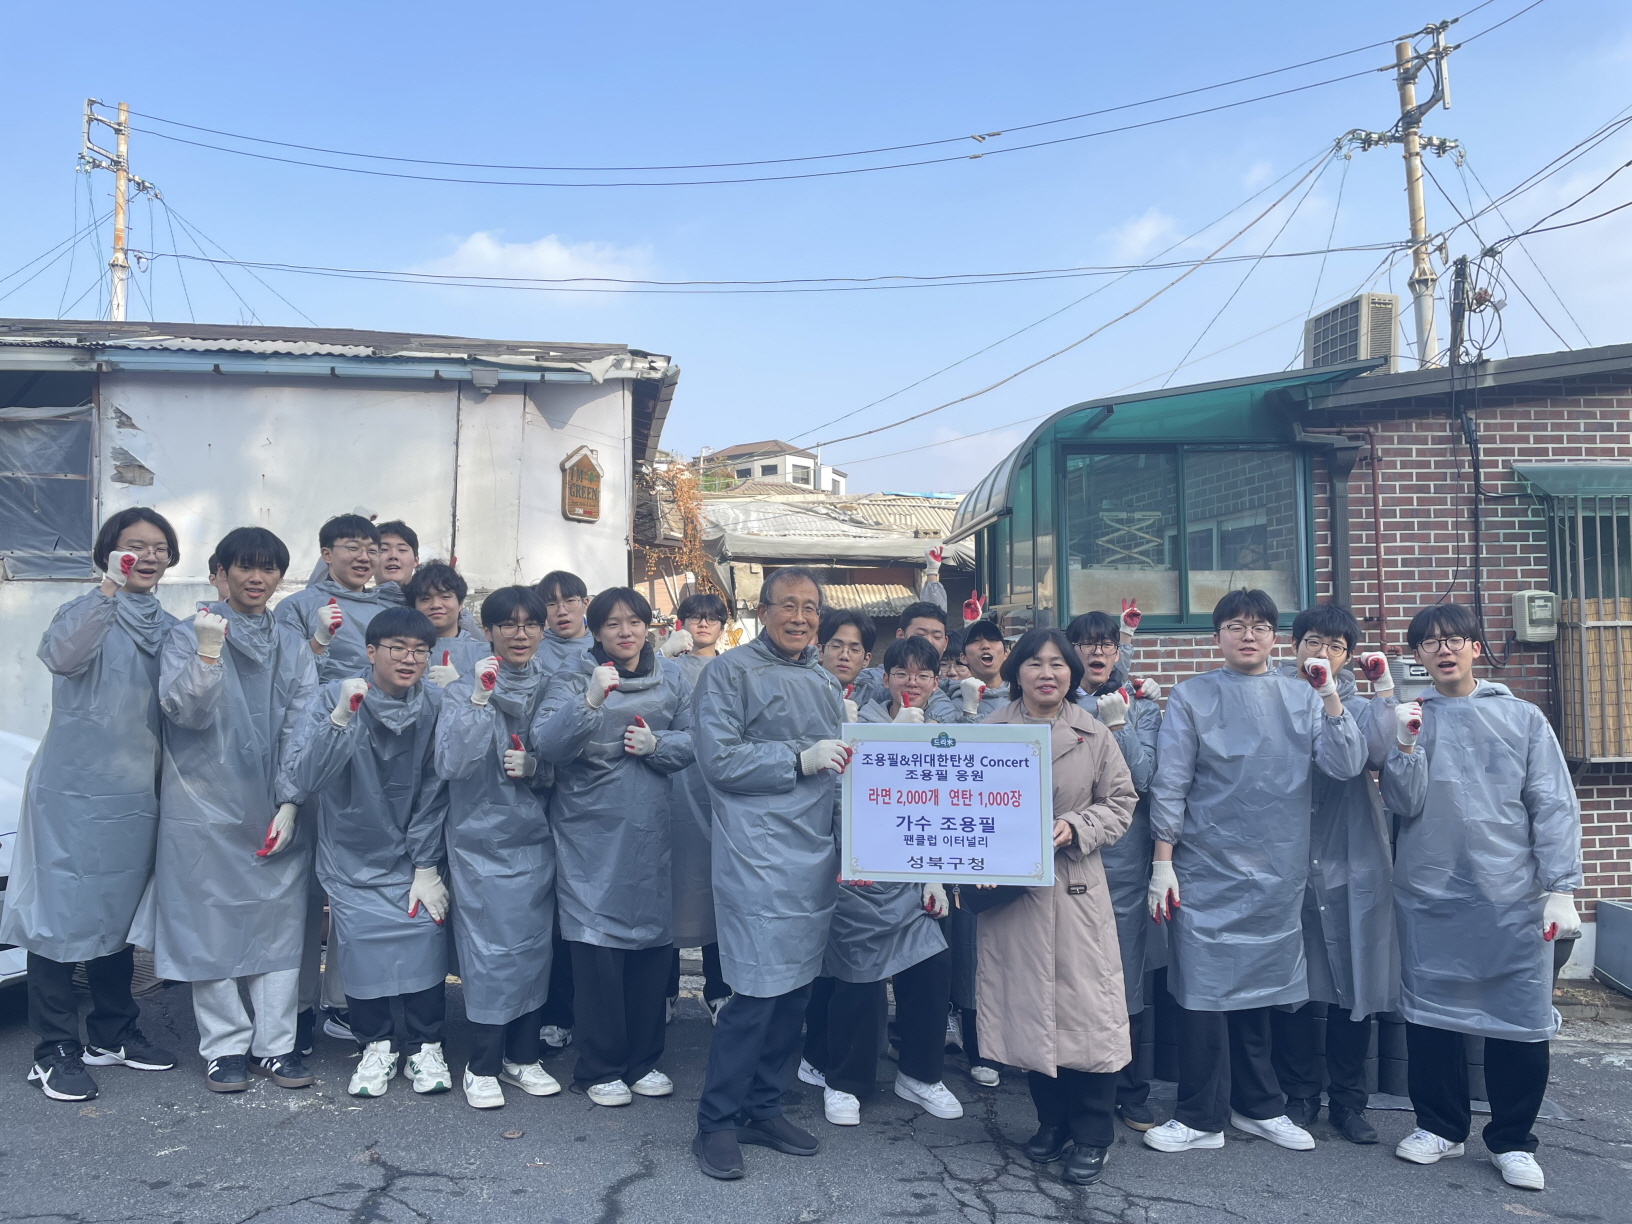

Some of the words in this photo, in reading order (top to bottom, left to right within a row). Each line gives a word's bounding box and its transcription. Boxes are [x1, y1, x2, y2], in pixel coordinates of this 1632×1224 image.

[569, 483, 600, 502] GREEN
[861, 753, 975, 768] 조용필&위대한탄생
[980, 756, 1030, 768] Concert
[904, 769, 949, 782] 조용필
[955, 769, 985, 782] 응원
[868, 787, 892, 805] 라면
[896, 788, 940, 806] 2,000개
[948, 789, 973, 806] 연탄
[978, 790, 1022, 808] 1,000장
[896, 815, 932, 832] 가수
[940, 816, 995, 833] 조용필
[903, 834, 938, 847] 팬클럽
[942, 835, 988, 848] 이터널리
[906, 855, 985, 871] 성북구청
